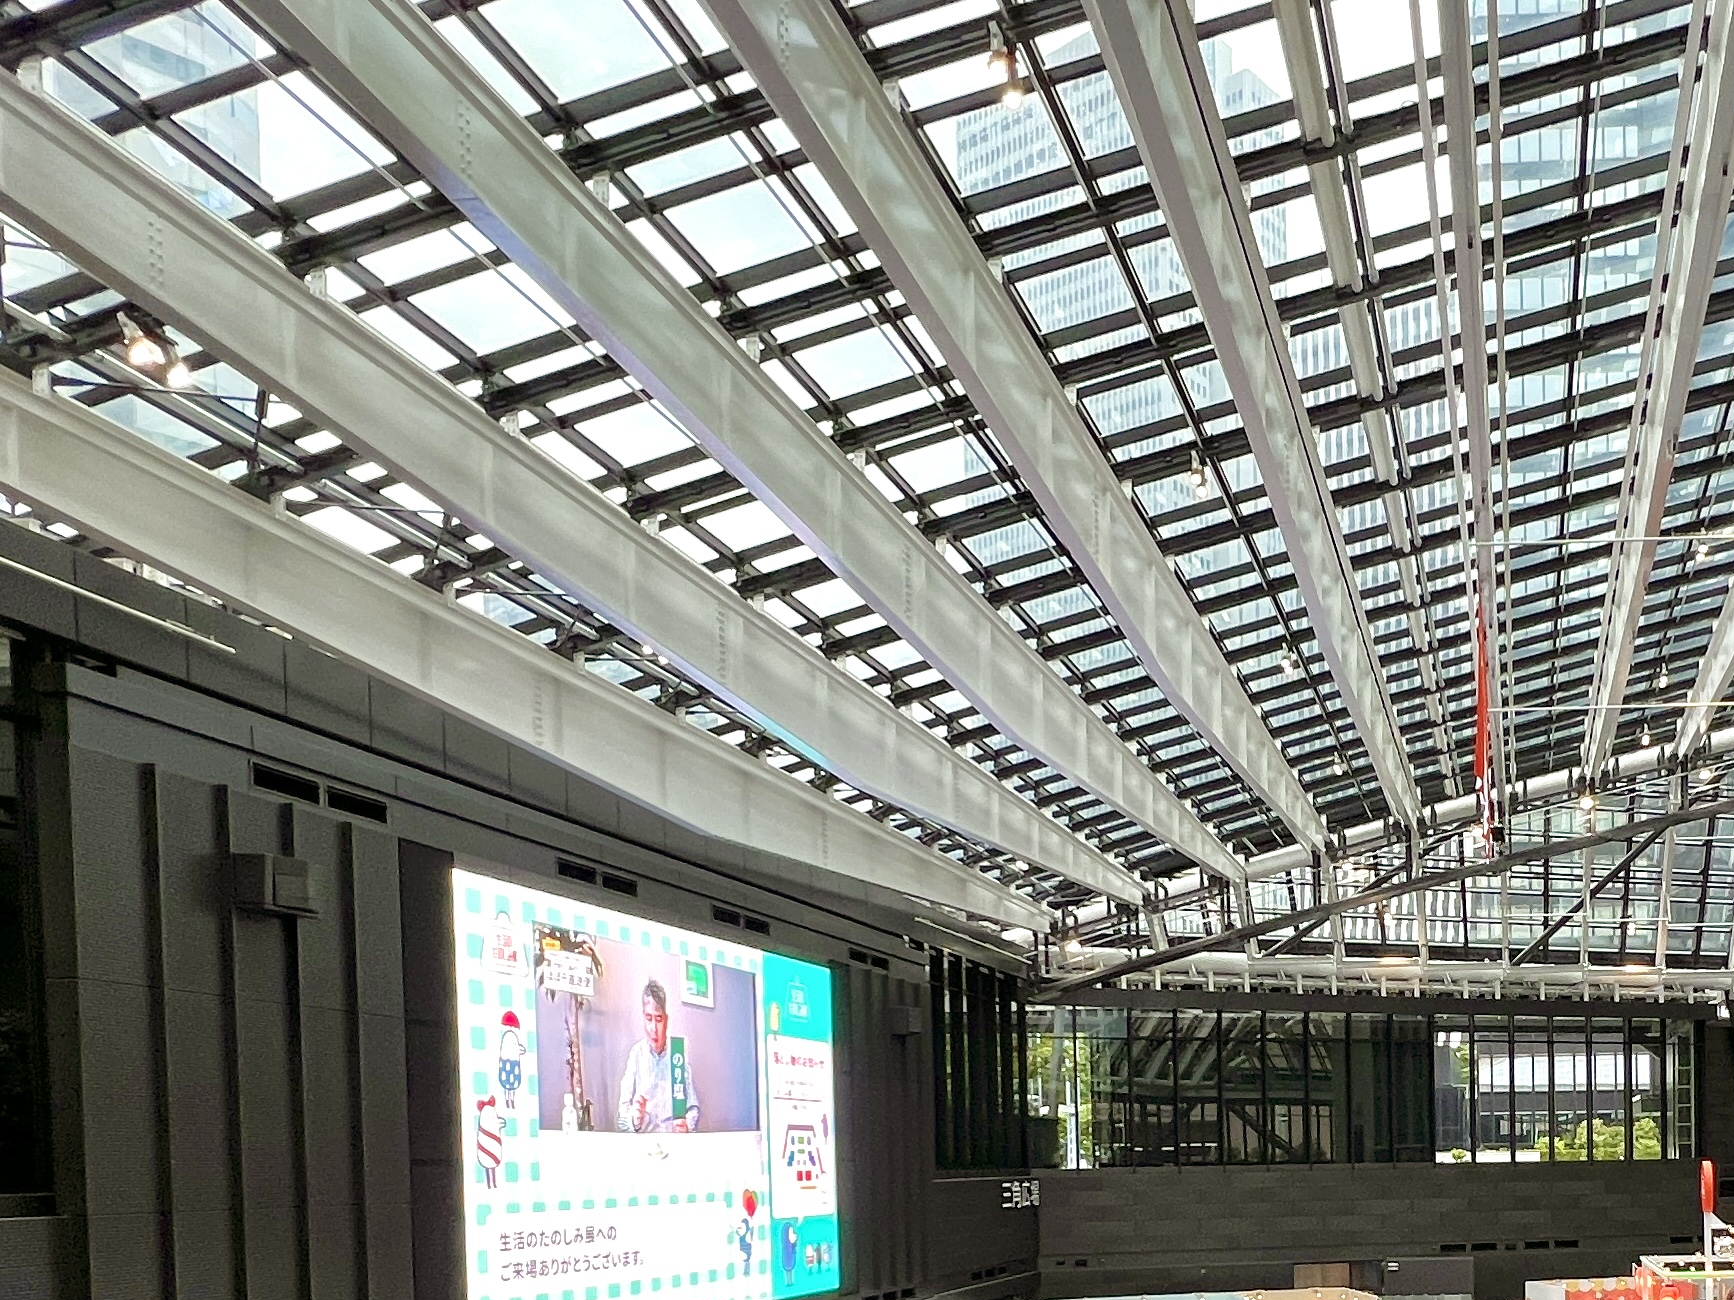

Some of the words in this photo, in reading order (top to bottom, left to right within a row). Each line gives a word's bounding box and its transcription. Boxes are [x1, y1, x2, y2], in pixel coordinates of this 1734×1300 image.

[1001, 1180, 1040, 1209] 三角広場
[499, 1225, 617, 1252] 生活のたのしみ展への
[500, 1250, 644, 1281] ご来場ありがとうございます。
